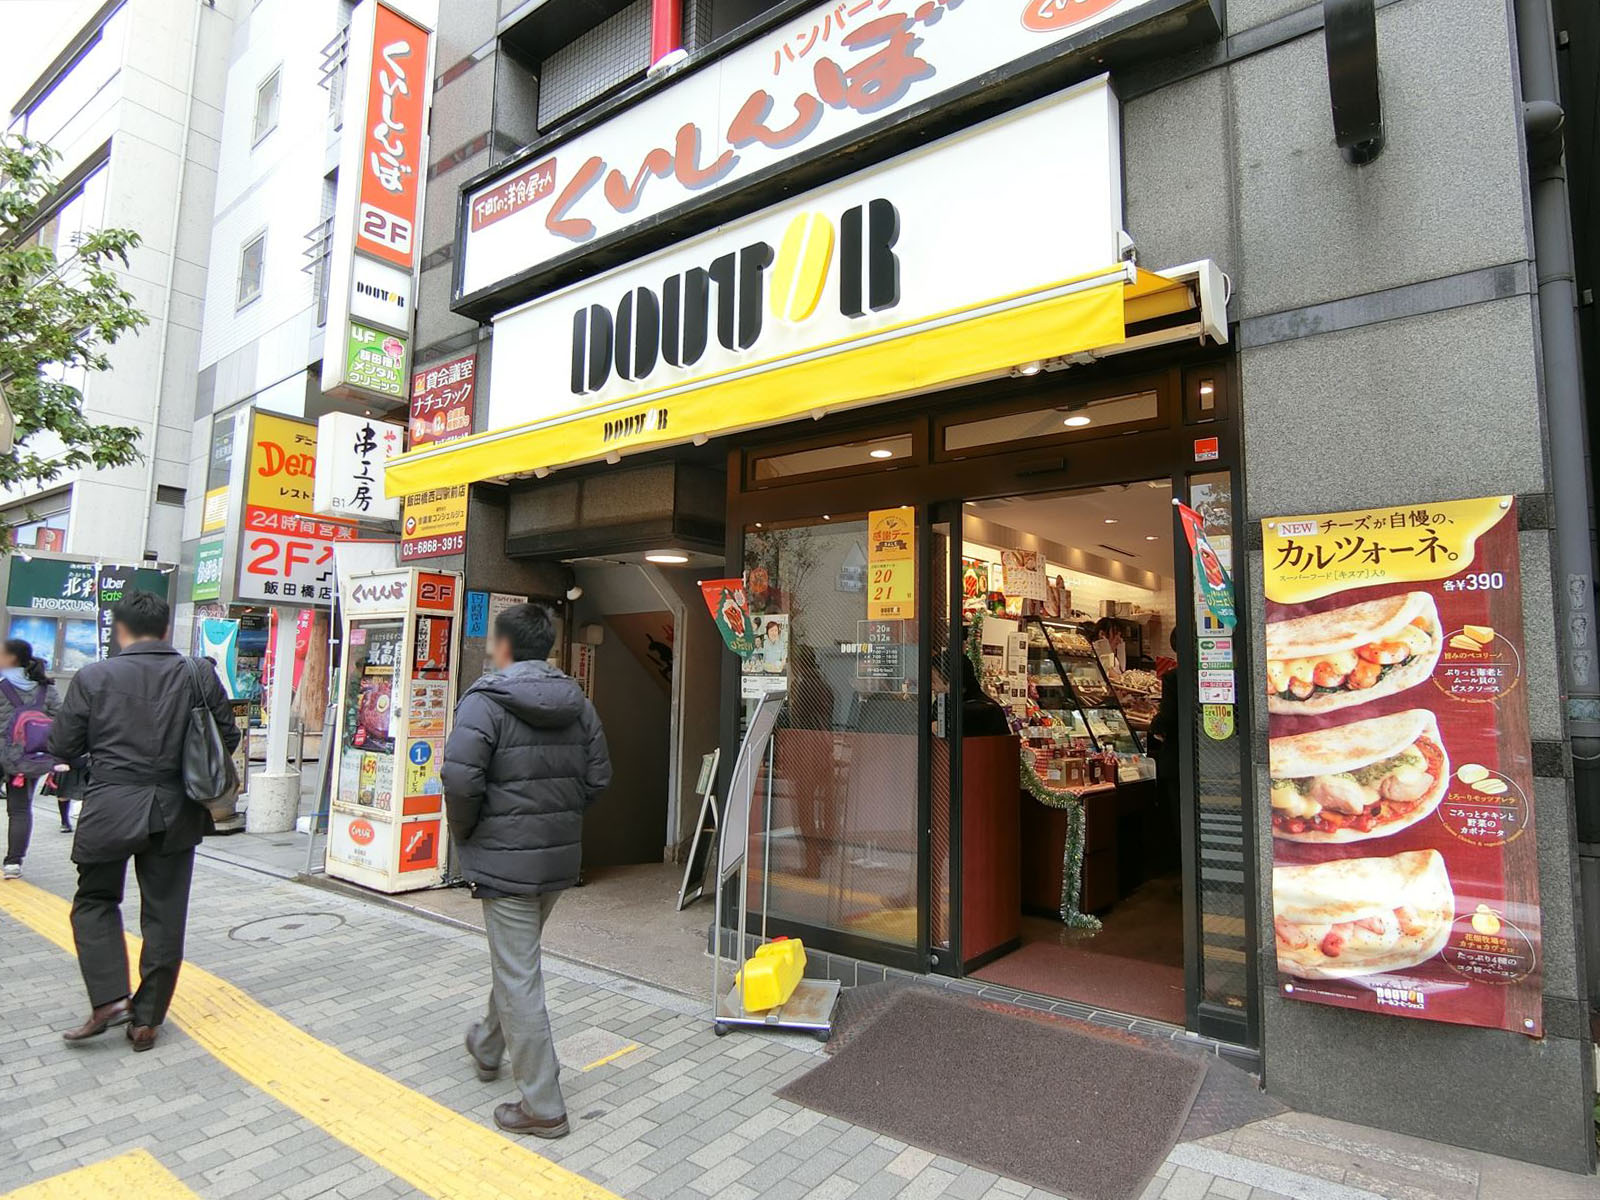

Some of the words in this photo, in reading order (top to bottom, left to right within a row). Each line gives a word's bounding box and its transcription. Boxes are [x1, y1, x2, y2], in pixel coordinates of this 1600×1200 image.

[774, 0, 895, 76] ハンバー
[364, 211, 409, 244] 2F
[356, 281, 405, 308] DOUTOR
[571, 198, 901, 395] DOUTOR
[351, 326, 376, 344] 4F
[353, 361, 397, 381] メンタル
[426, 359, 473, 392] 貸会議室
[349, 372, 400, 394] クリニック
[603, 408, 668, 443] DOUTOR
[1281, 522, 1314, 535] NEW
[1319, 509, 1455, 535] チーズが自慢の、
[403, 535, 463, 556] 03-6868-3915
[1273, 529, 1459, 573] カルツォーネ。
[247, 537, 314, 578] 2F
[102, 578, 126, 590] Uber
[874, 569, 893, 584] 20
[101, 591, 123, 602] Eats
[264, 580, 333, 600] 飯田橋店
[421, 583, 451, 601] 2F
[873, 586, 893, 600] 21
